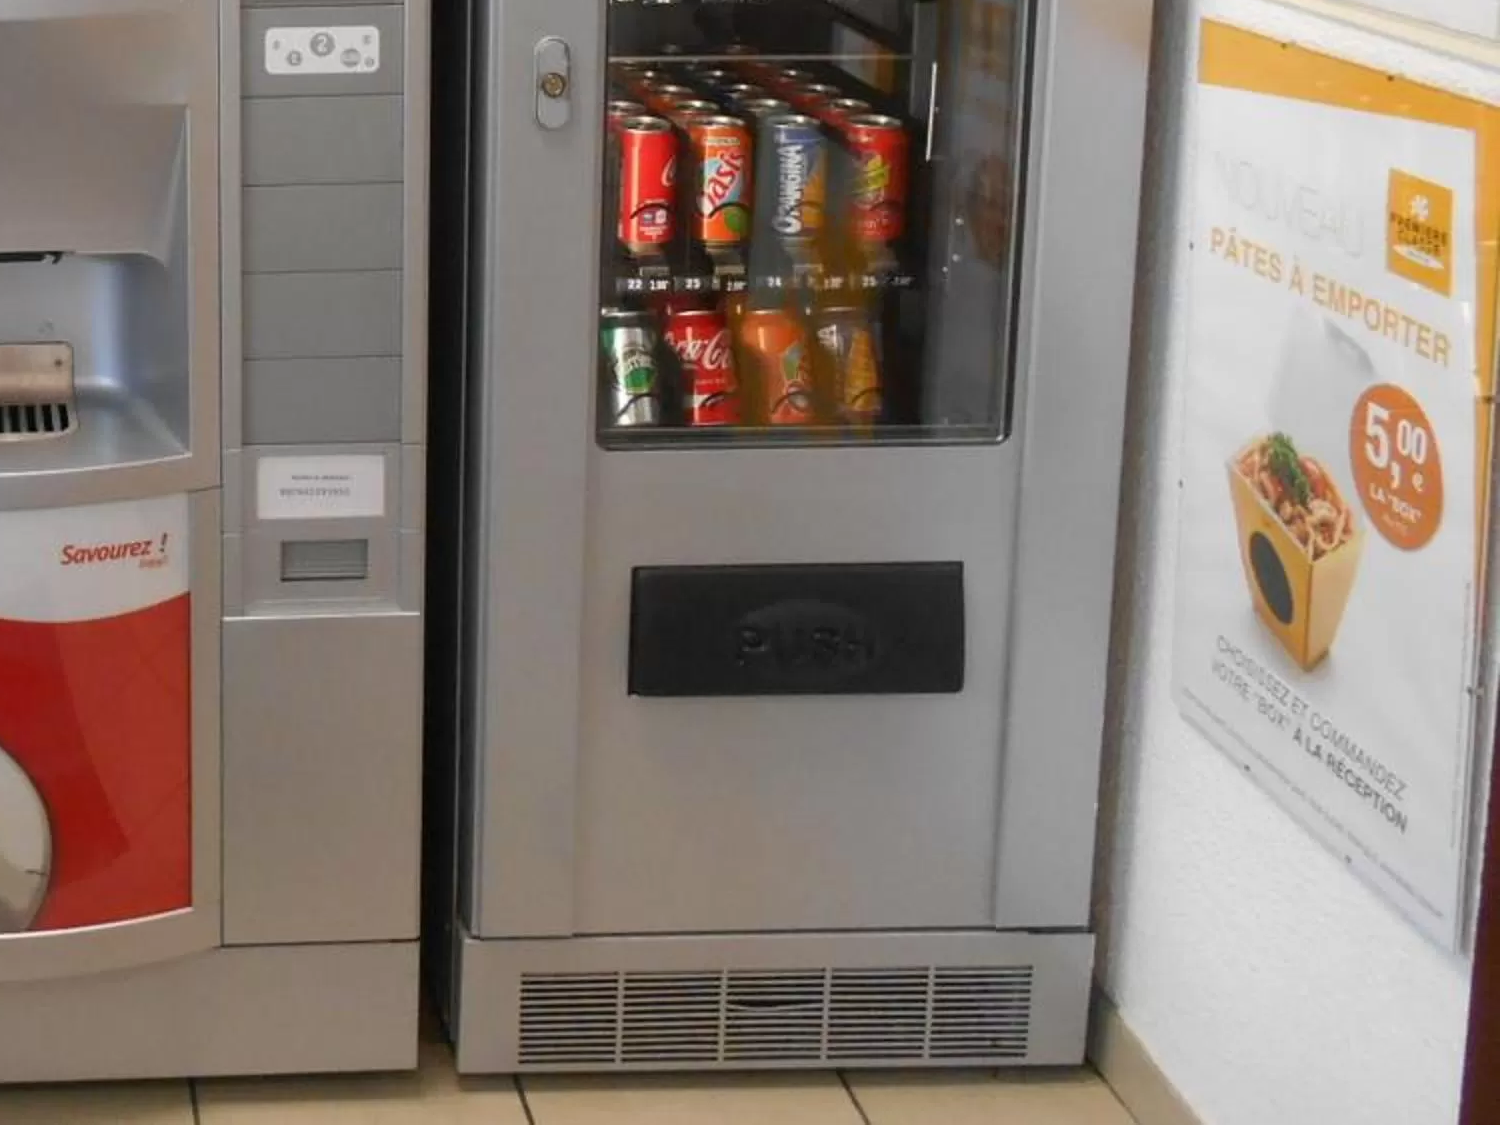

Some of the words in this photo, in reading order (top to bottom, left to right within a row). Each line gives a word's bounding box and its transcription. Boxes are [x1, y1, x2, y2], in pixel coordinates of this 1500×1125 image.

[1213, 153, 1365, 258] NOUVEAU
[1210, 227, 1283, 284] PÂTES
[1288, 252, 1304, 297] À
[1311, 273, 1453, 368] EMPORTER
[61, 539, 153, 566] Savourez
[1216, 635, 1288, 708] CHOISISSEZ
[1289, 698, 1308, 719] ET
[1310, 711, 1408, 801] COMMANDEZ
[1304, 737, 1323, 763] LA
[1326, 753, 1408, 835] RÉCEPTION
